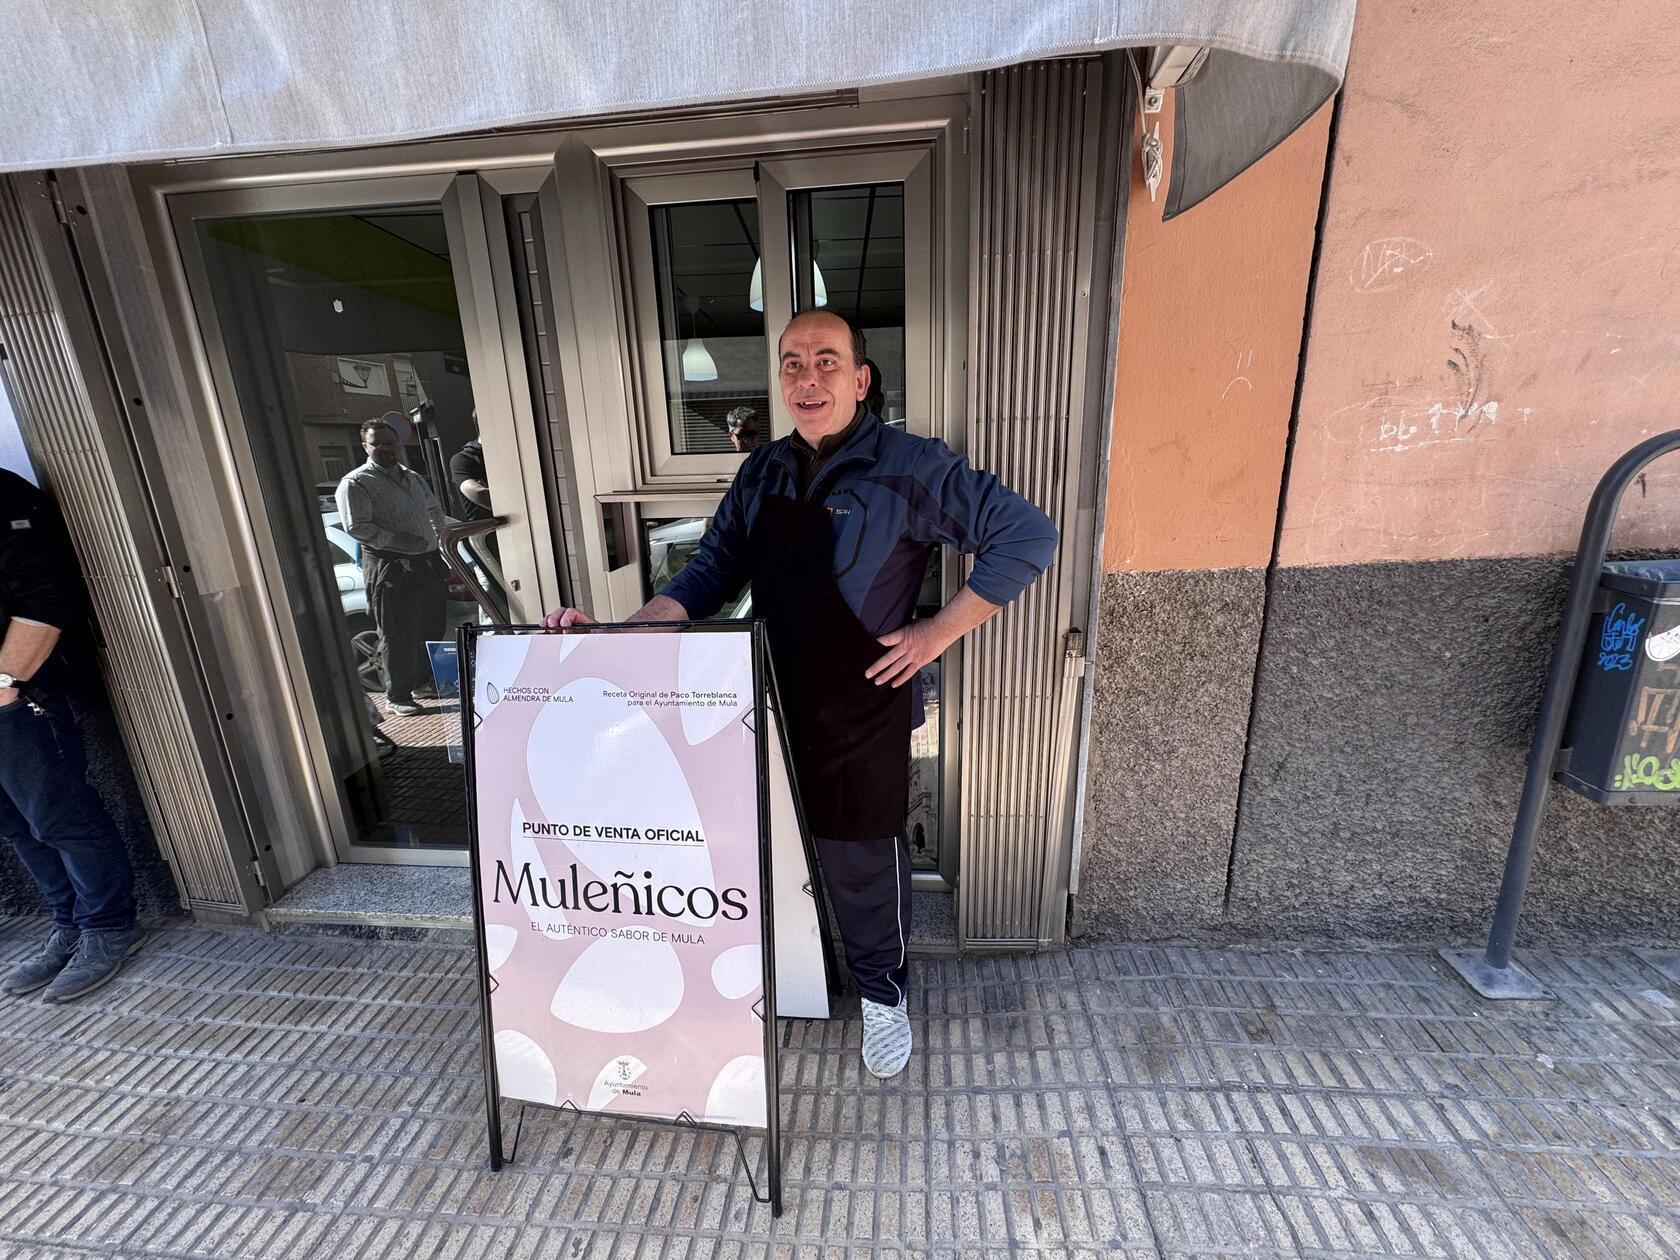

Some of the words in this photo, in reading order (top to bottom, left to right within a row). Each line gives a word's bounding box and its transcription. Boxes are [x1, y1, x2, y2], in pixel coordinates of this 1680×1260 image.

[503, 694, 541, 702] ALMENDRA
[542, 695, 551, 703] DE
[553, 695, 574, 703] MULA
[602, 690, 627, 698] Receta
[628, 690, 657, 700] Original
[658, 691, 669, 699] de
[670, 691, 690, 699] Paco
[691, 691, 737, 699] Torreblanca
[627, 700, 643, 708] para
[645, 699, 652, 707] el
[653, 699, 704, 708] Ayuntamiento
[706, 699, 717, 707] de
[718, 699, 738, 707] Mula
[522, 821, 570, 836] PUNTO
[573, 823, 591, 838] DE
[594, 824, 641, 840] VENTA
[644, 827, 705, 842] OFICIAL
[492, 859, 749, 921] Muleñicos
[531, 921, 543, 933] EL
[546, 922, 608, 938] AUTÉNTICO
[610, 928, 650, 941] SABOR
[653, 931, 668, 942] DE
[671, 933, 705, 945] MULA
[604, 1080, 648, 1090] Ayuntamiento
